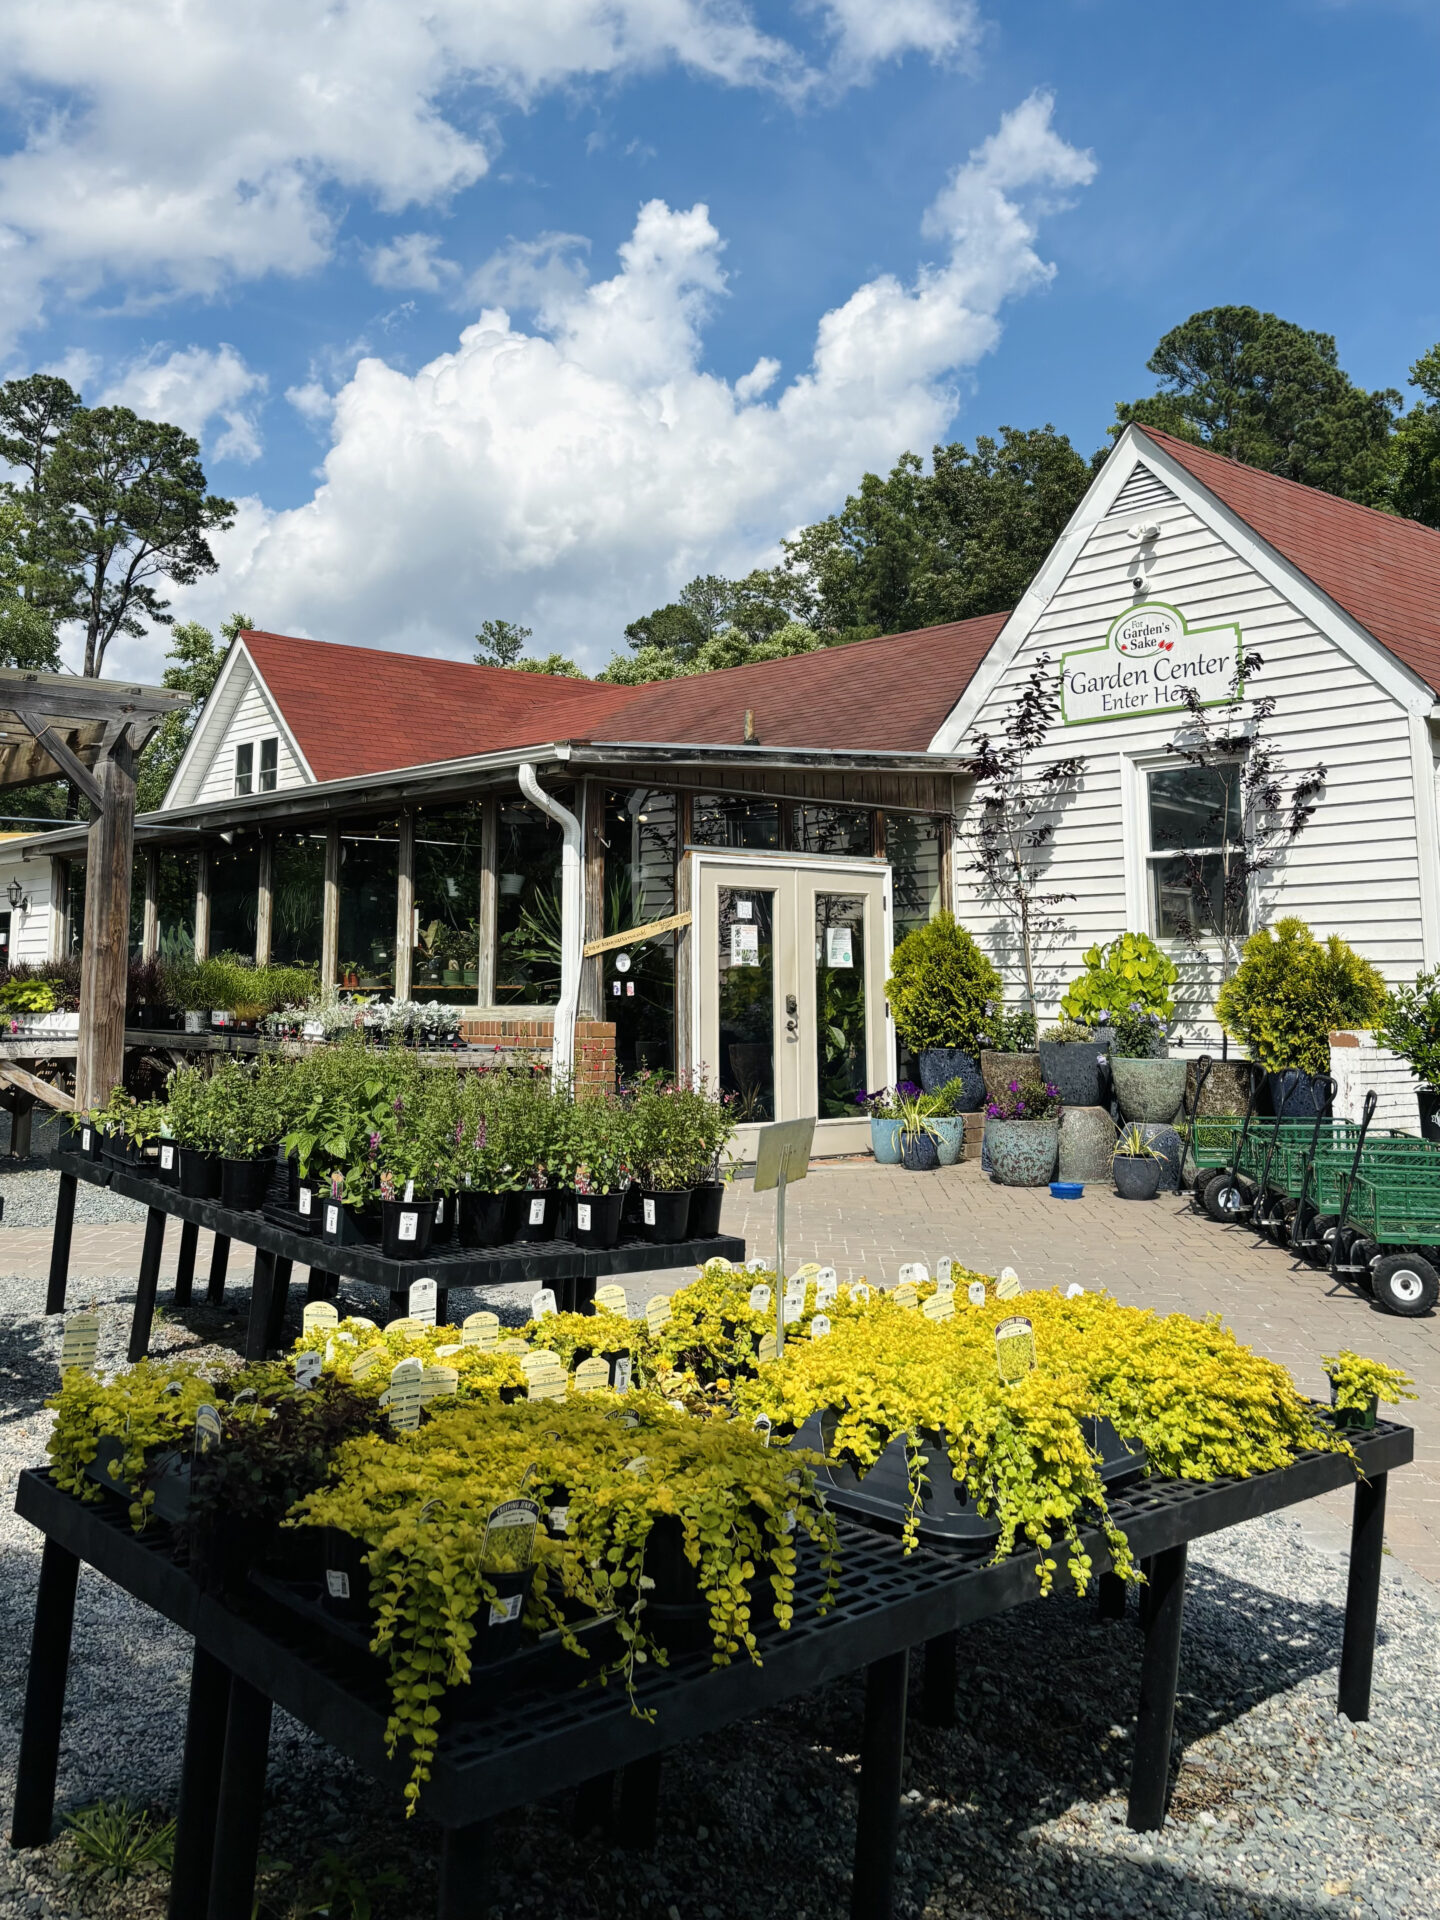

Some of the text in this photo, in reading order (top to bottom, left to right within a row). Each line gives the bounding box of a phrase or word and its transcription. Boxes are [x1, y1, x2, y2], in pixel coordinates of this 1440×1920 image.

[1123, 622, 1170, 640] Garden's
[1131, 620, 1144, 629] For
[1130, 636, 1157, 651] Sake
[1070, 653, 1230, 695] Garden Center
[1102, 685, 1197, 712] Enter Her
